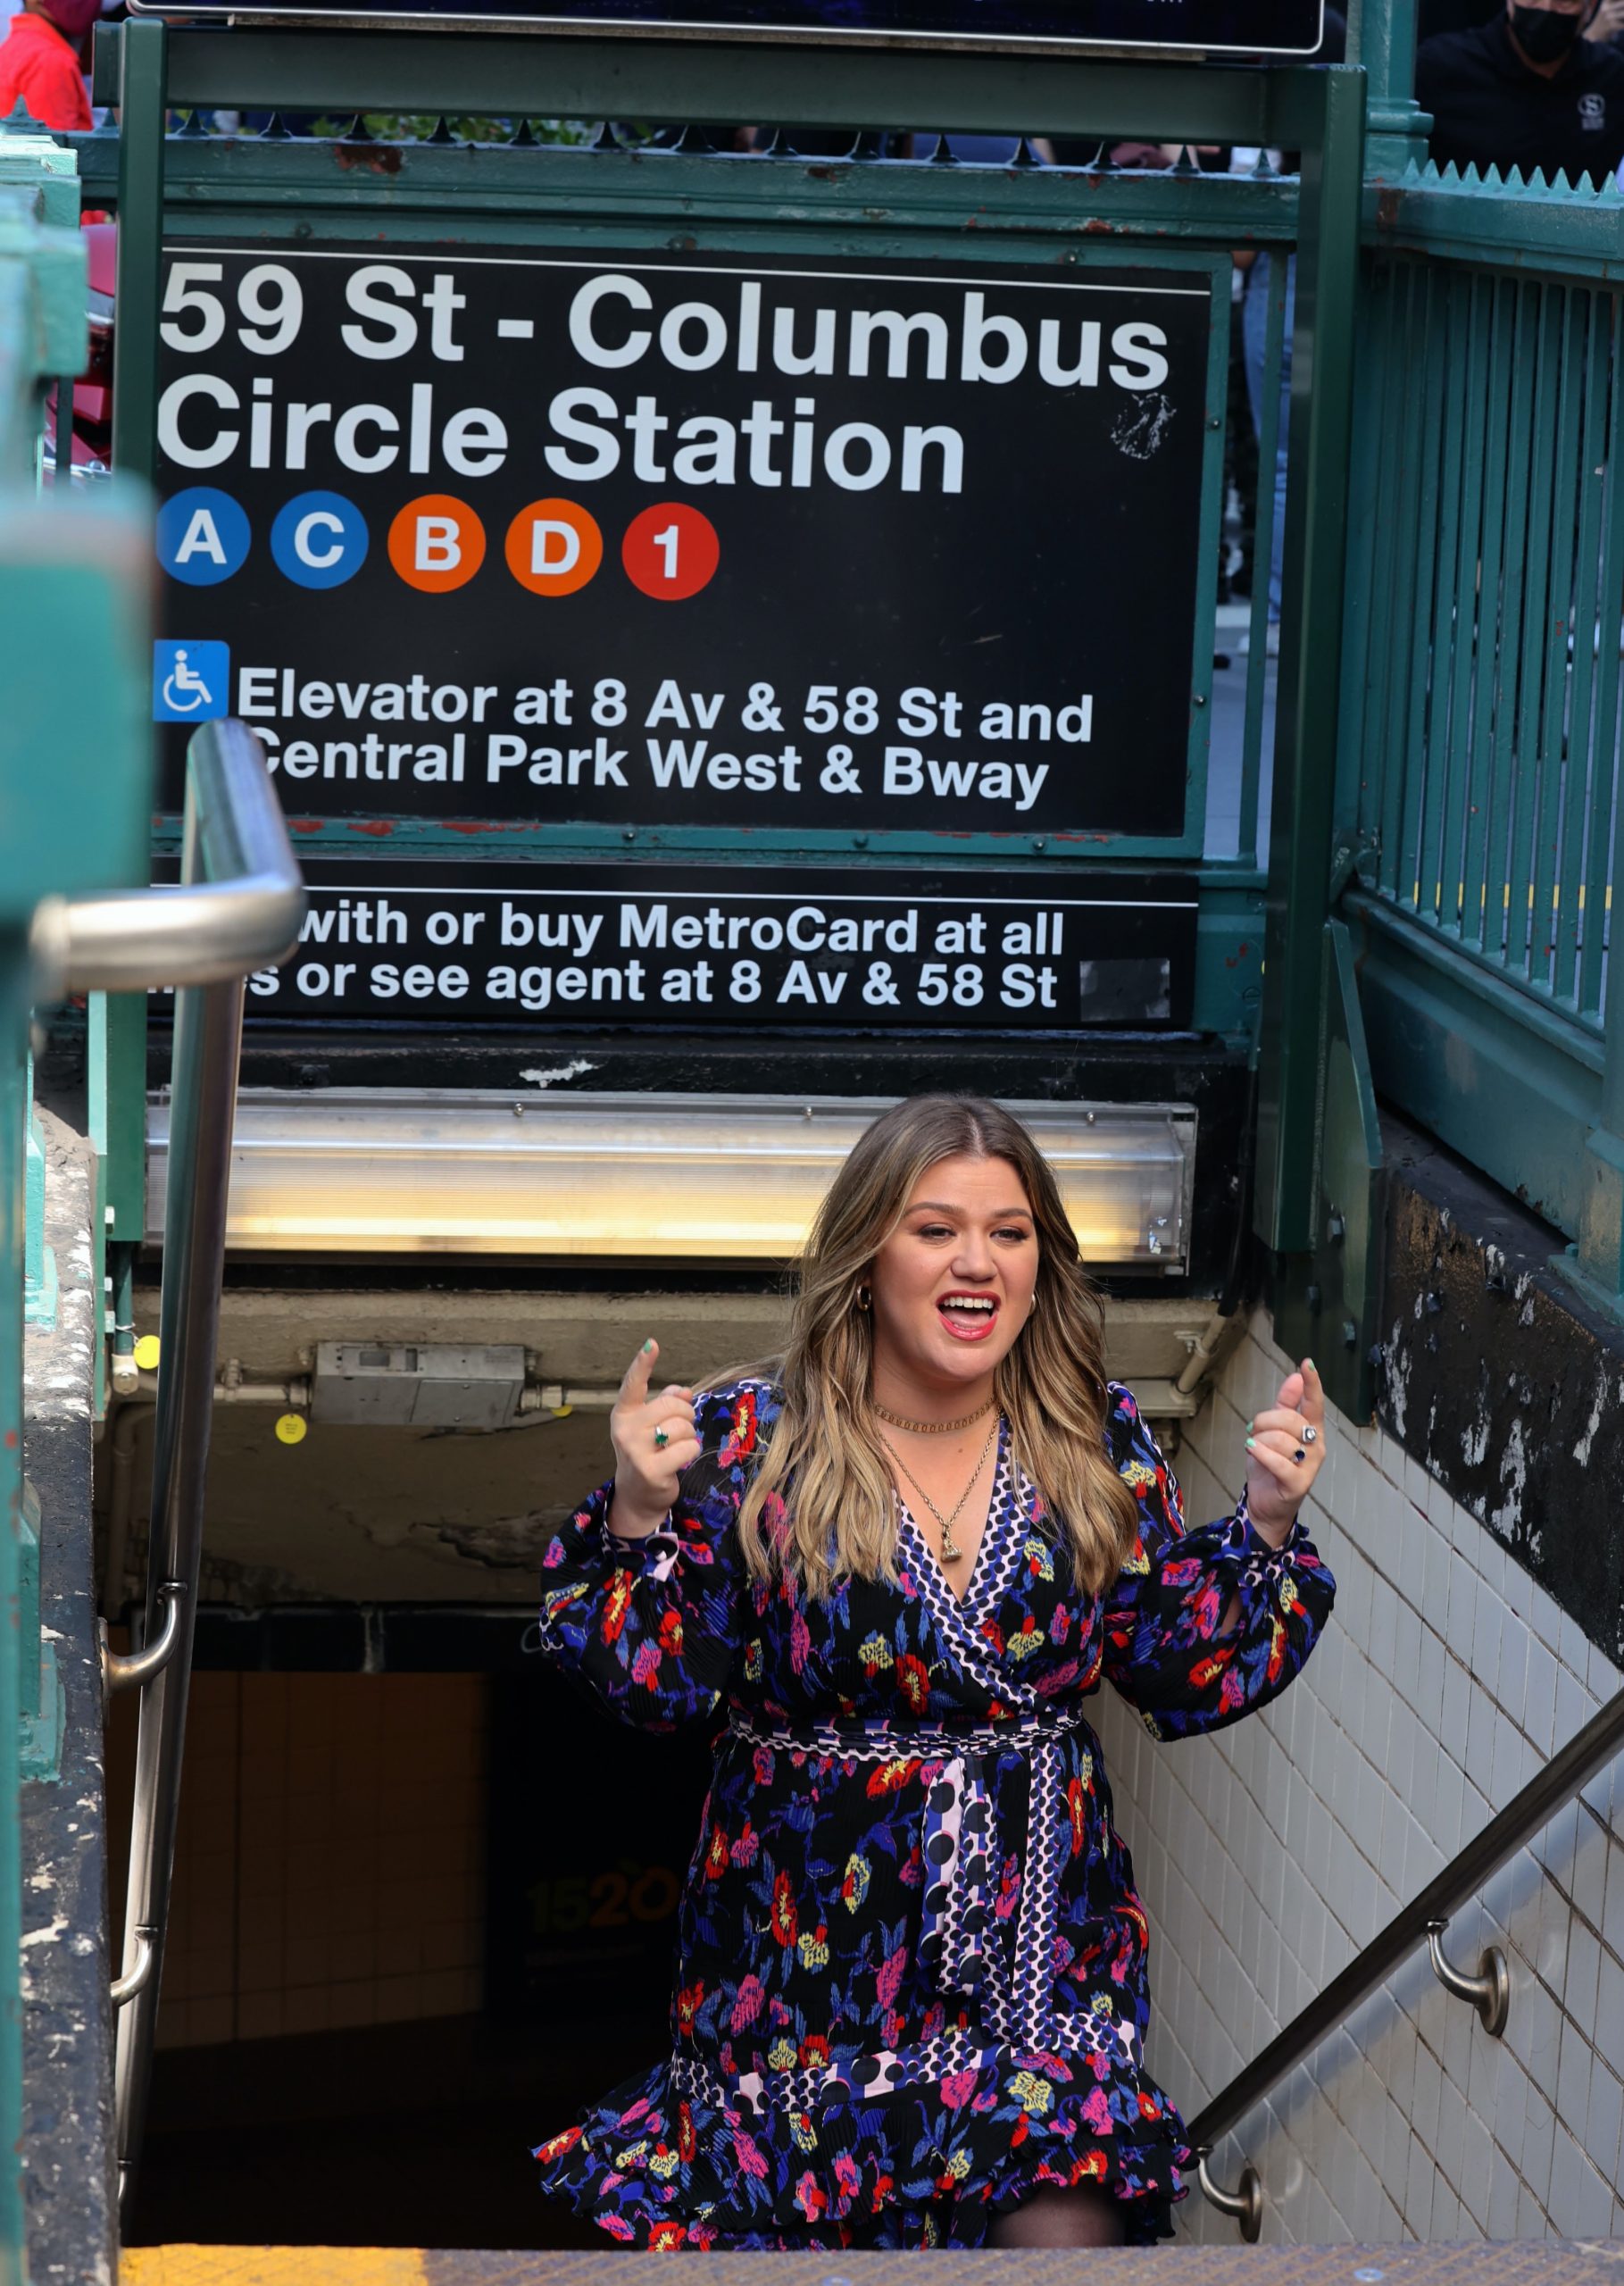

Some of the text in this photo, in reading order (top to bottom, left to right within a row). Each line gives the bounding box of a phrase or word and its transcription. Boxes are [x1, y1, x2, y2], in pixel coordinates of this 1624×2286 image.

[160, 263, 303, 355] 59
[341, 265, 465, 361] St
[570, 274, 1168, 389] Columbus
[158, 374, 964, 493] Circle Station
[175, 509, 679, 578] A C B D 1
[238, 668, 1092, 742] Elevator at 8 Av & 58 St and
[487, 735, 629, 786] Park
[645, 739, 802, 791] West
[820, 745, 862, 793] &
[884, 747, 1049, 810] Bway
[297, 900, 1062, 956] with or buy MetroCard at all
[297, 964, 355, 996] or
[371, 964, 469, 998] see
[486, 960, 645, 1010] agent
[661, 961, 713, 1002] at
[729, 960, 761, 1002] 8
[777, 961, 847, 1003] Av
[862, 962, 900, 1005] &
[918, 964, 983, 1006] 58
[1001, 964, 1057, 1007] St
